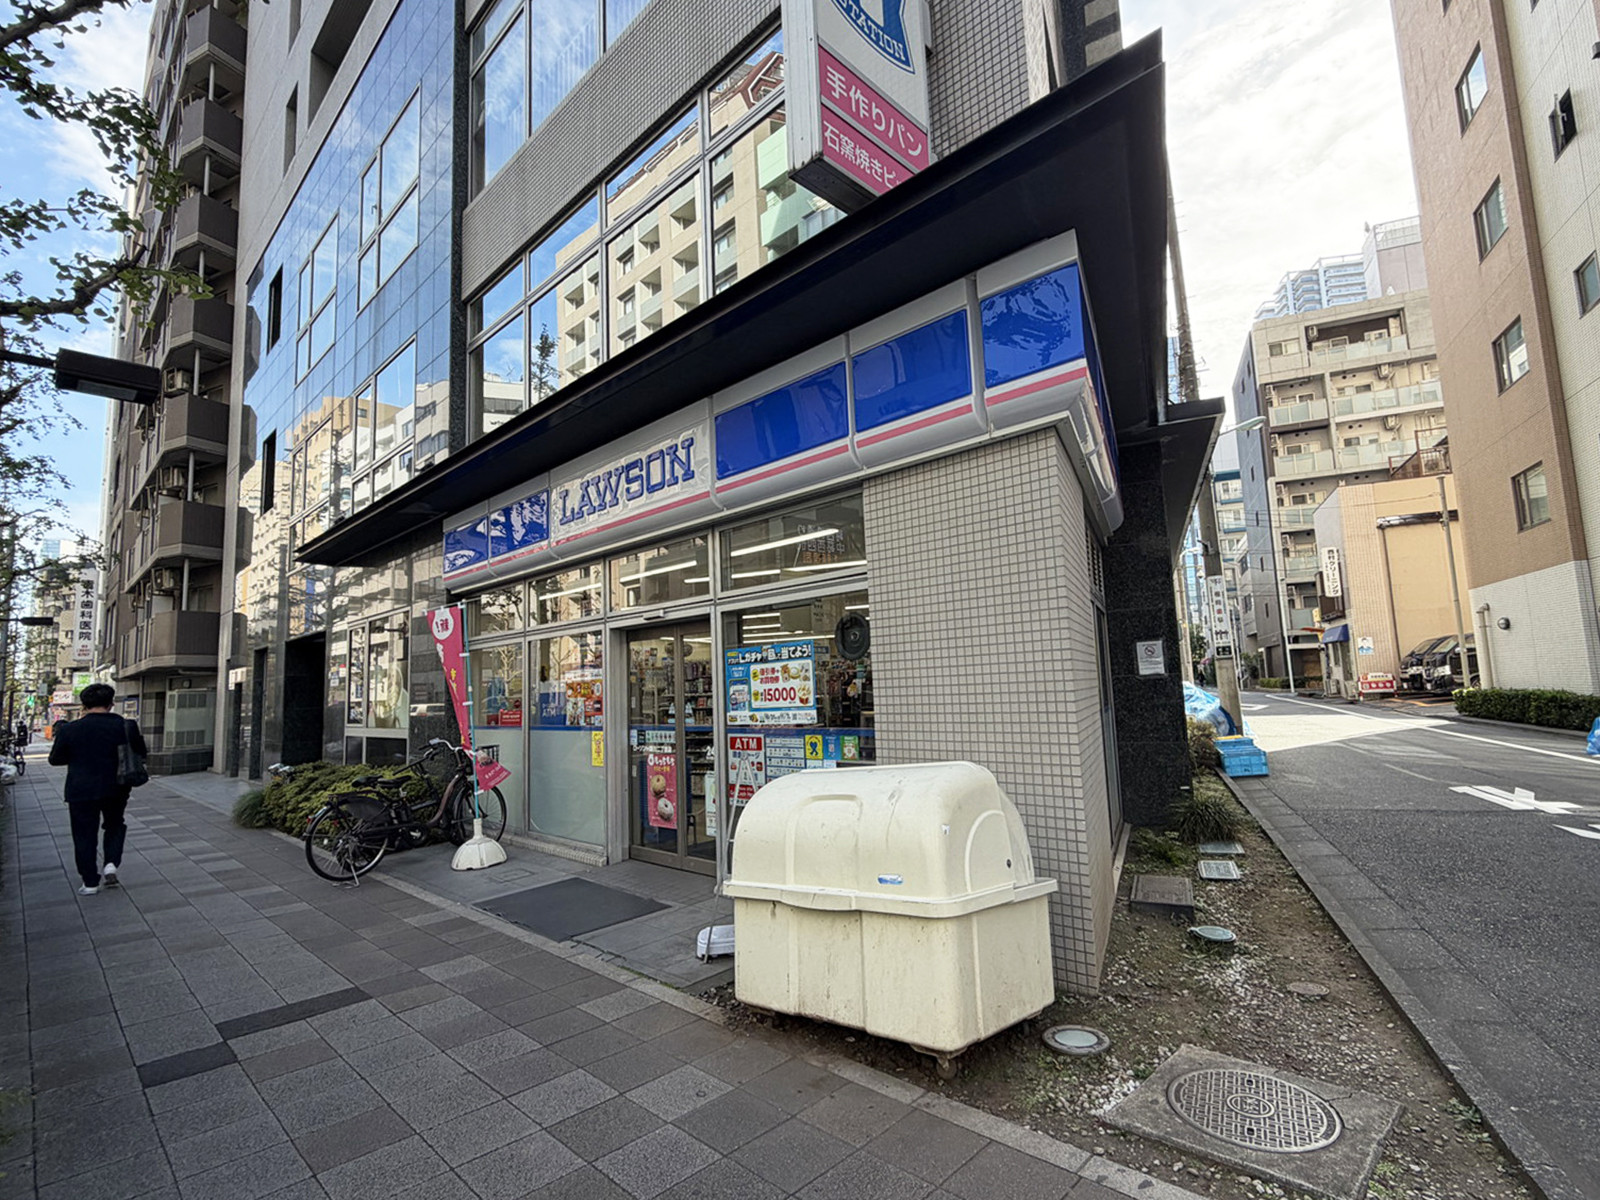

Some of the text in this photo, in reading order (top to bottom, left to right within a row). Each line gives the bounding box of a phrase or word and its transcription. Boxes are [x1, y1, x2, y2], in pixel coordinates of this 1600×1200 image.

[826, 64, 923, 158] 手作りパン
[559, 436, 696, 526] LAWSON
[763, 686, 797, 703] 15000
[735, 737, 757, 750] ATM
